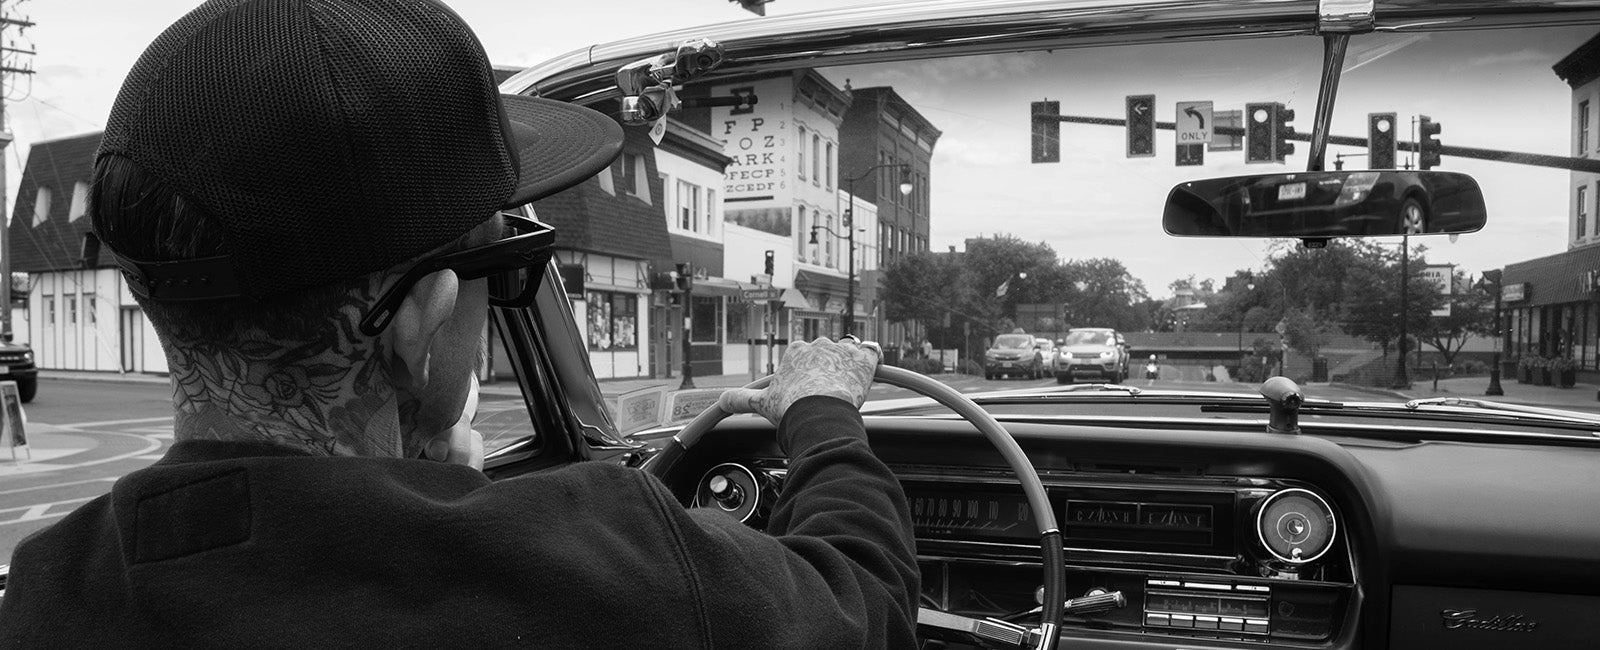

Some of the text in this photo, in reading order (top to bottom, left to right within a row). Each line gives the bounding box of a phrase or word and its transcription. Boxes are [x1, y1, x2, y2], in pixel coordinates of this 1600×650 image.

[730, 86, 754, 115] E
[1181, 131, 1208, 141] ONLY
[724, 182, 775, 193] ZCEDF
[743, 290, 768, 299] Cornell
[927, 498, 935, 517] 70
[938, 498, 948, 517] 80
[952, 499, 962, 518] 90
[967, 499, 979, 519] 100
[988, 500, 999, 520] 110
[1018, 502, 1029, 522] 120
[1123, 512, 1129, 523] H
[1443, 609, 1537, 632] Cadillac
